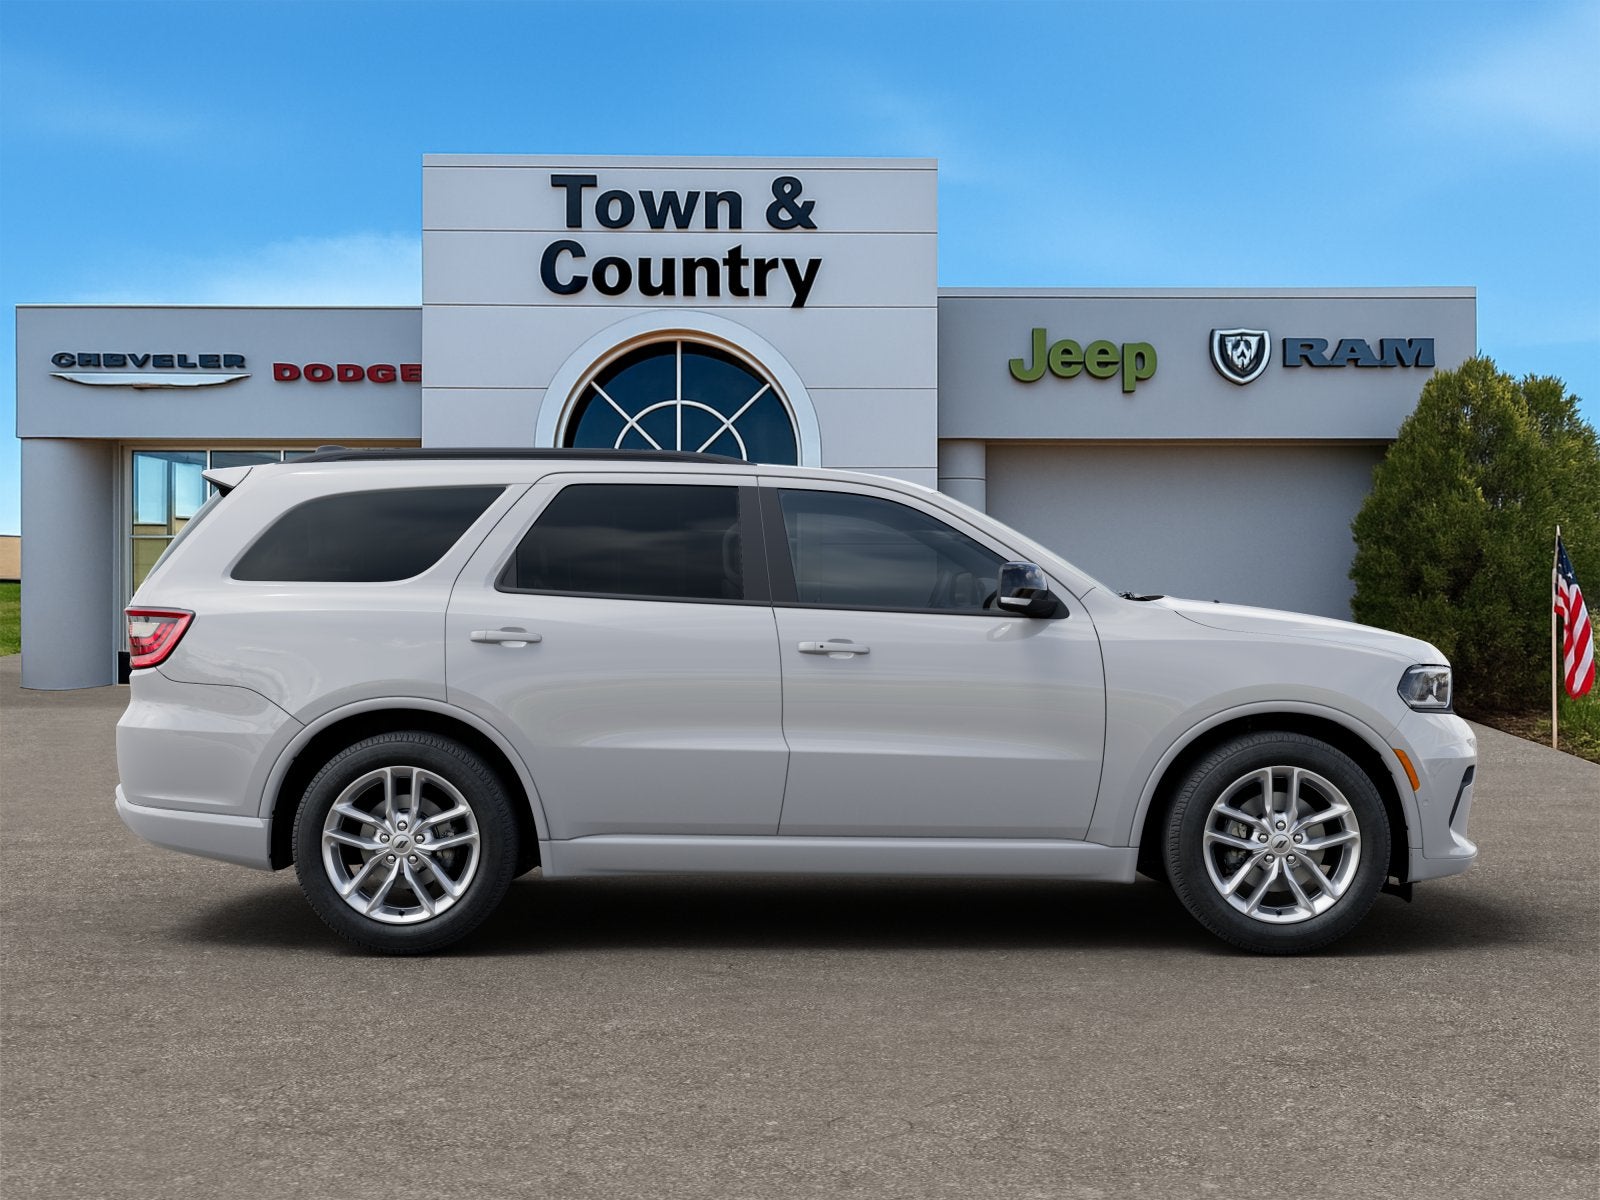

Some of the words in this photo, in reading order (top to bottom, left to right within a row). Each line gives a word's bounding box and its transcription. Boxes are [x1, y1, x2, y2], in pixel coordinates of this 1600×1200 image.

[550, 174, 742, 229] Town
[766, 175, 818, 230] &
[540, 239, 822, 308] Country
[273, 362, 422, 382] DODGE
[1009, 327, 1157, 392] Jeep
[1283, 337, 1436, 367] RAM
